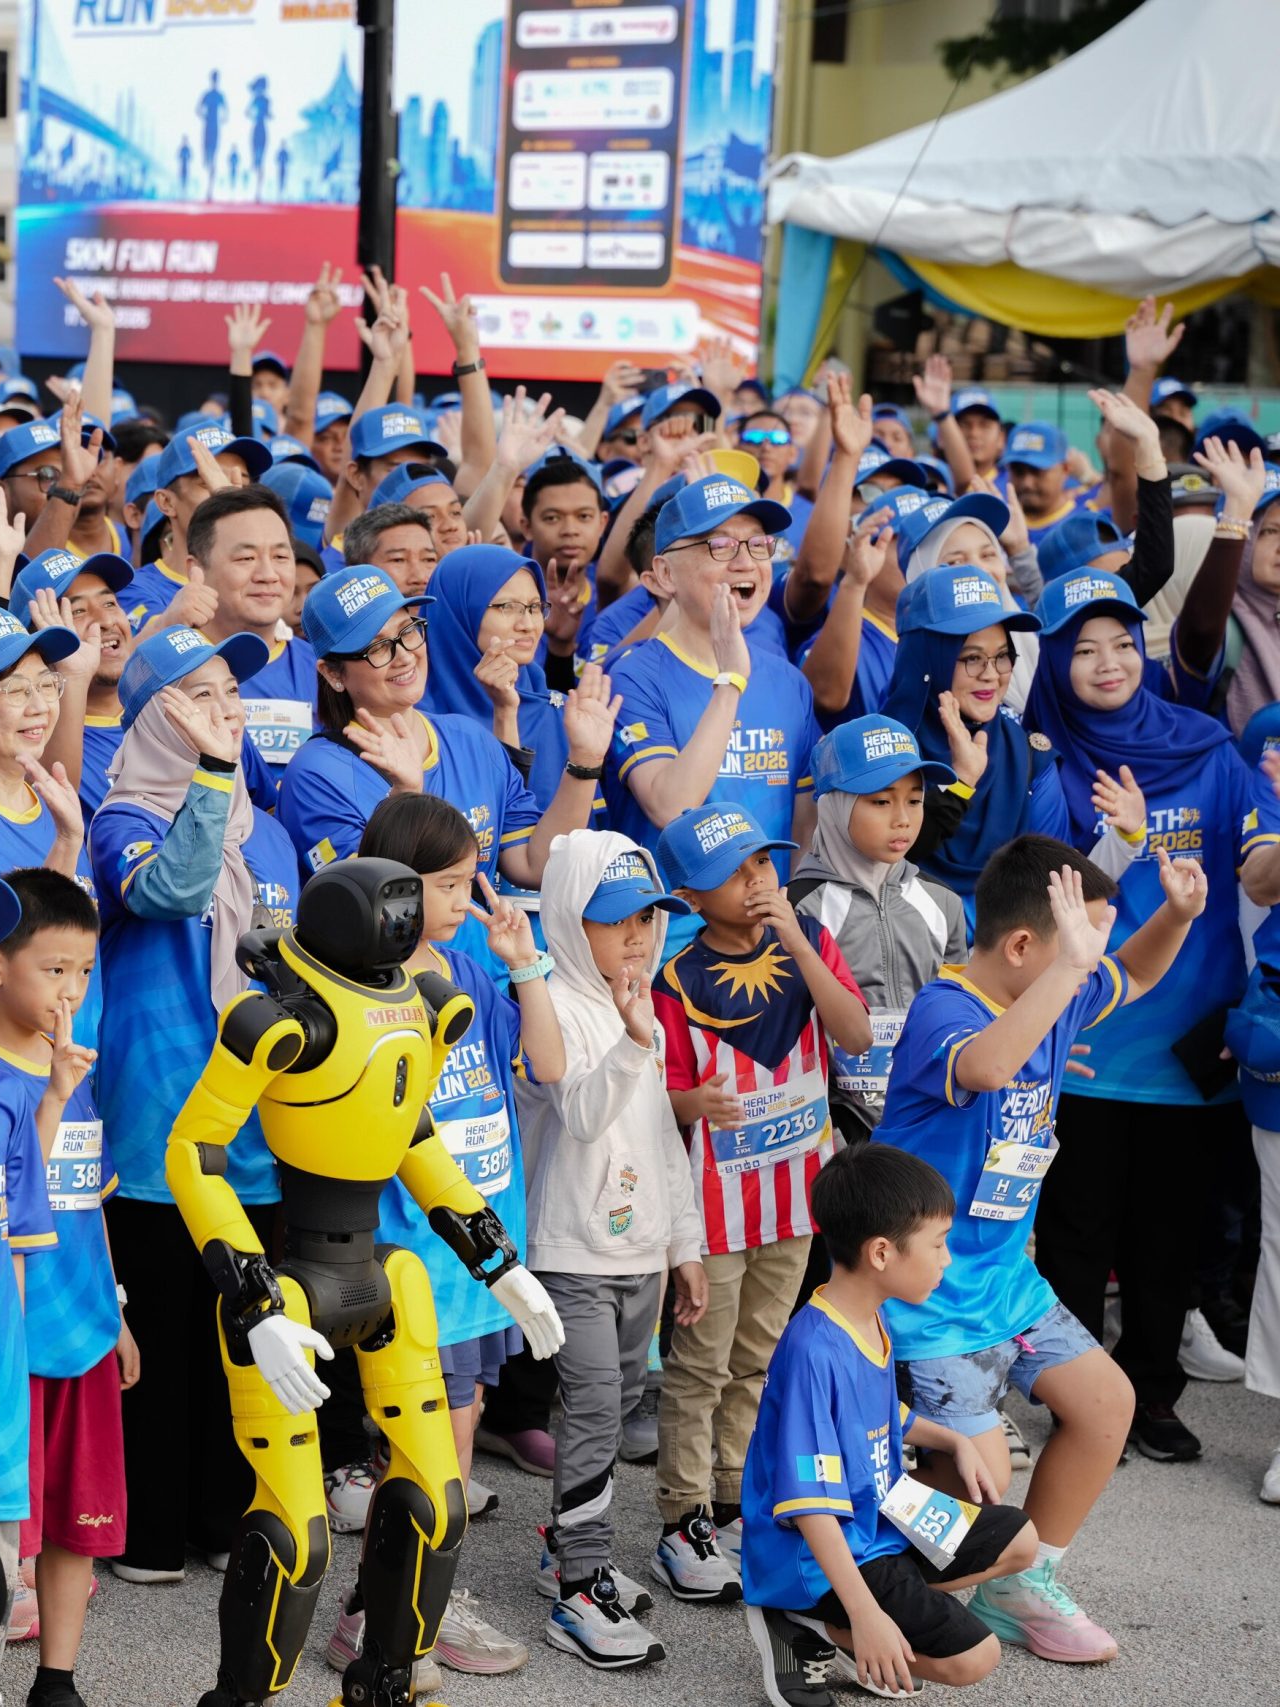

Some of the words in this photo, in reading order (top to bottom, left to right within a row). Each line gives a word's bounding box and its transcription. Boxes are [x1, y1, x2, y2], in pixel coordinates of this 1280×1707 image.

[116, 240, 166, 272] FUN
[166, 241, 219, 273] RUN
[707, 495, 732, 510] RUN
[343, 594, 367, 618] RUN
[954, 592, 980, 606] RUN
[1065, 592, 1091, 608] RUN
[175, 640, 201, 655] RUN
[251, 729, 300, 749] 3875
[866, 742, 893, 760] RUN
[719, 752, 742, 774] UN
[743, 751, 788, 772] 2026
[701, 829, 728, 854] RUN
[1149, 829, 1202, 853] 2026
[603, 866, 629, 880] RUN
[745, 1105, 766, 1119] RUN
[762, 1107, 817, 1148] 2236
[465, 1135, 485, 1147] RUN
[734, 1131, 746, 1146] F
[63, 1141, 83, 1152] RUN
[1017, 1162, 1036, 1173] RUN
[995, 1178, 1011, 1194] H
[77, 1513, 114, 1528] Safri
